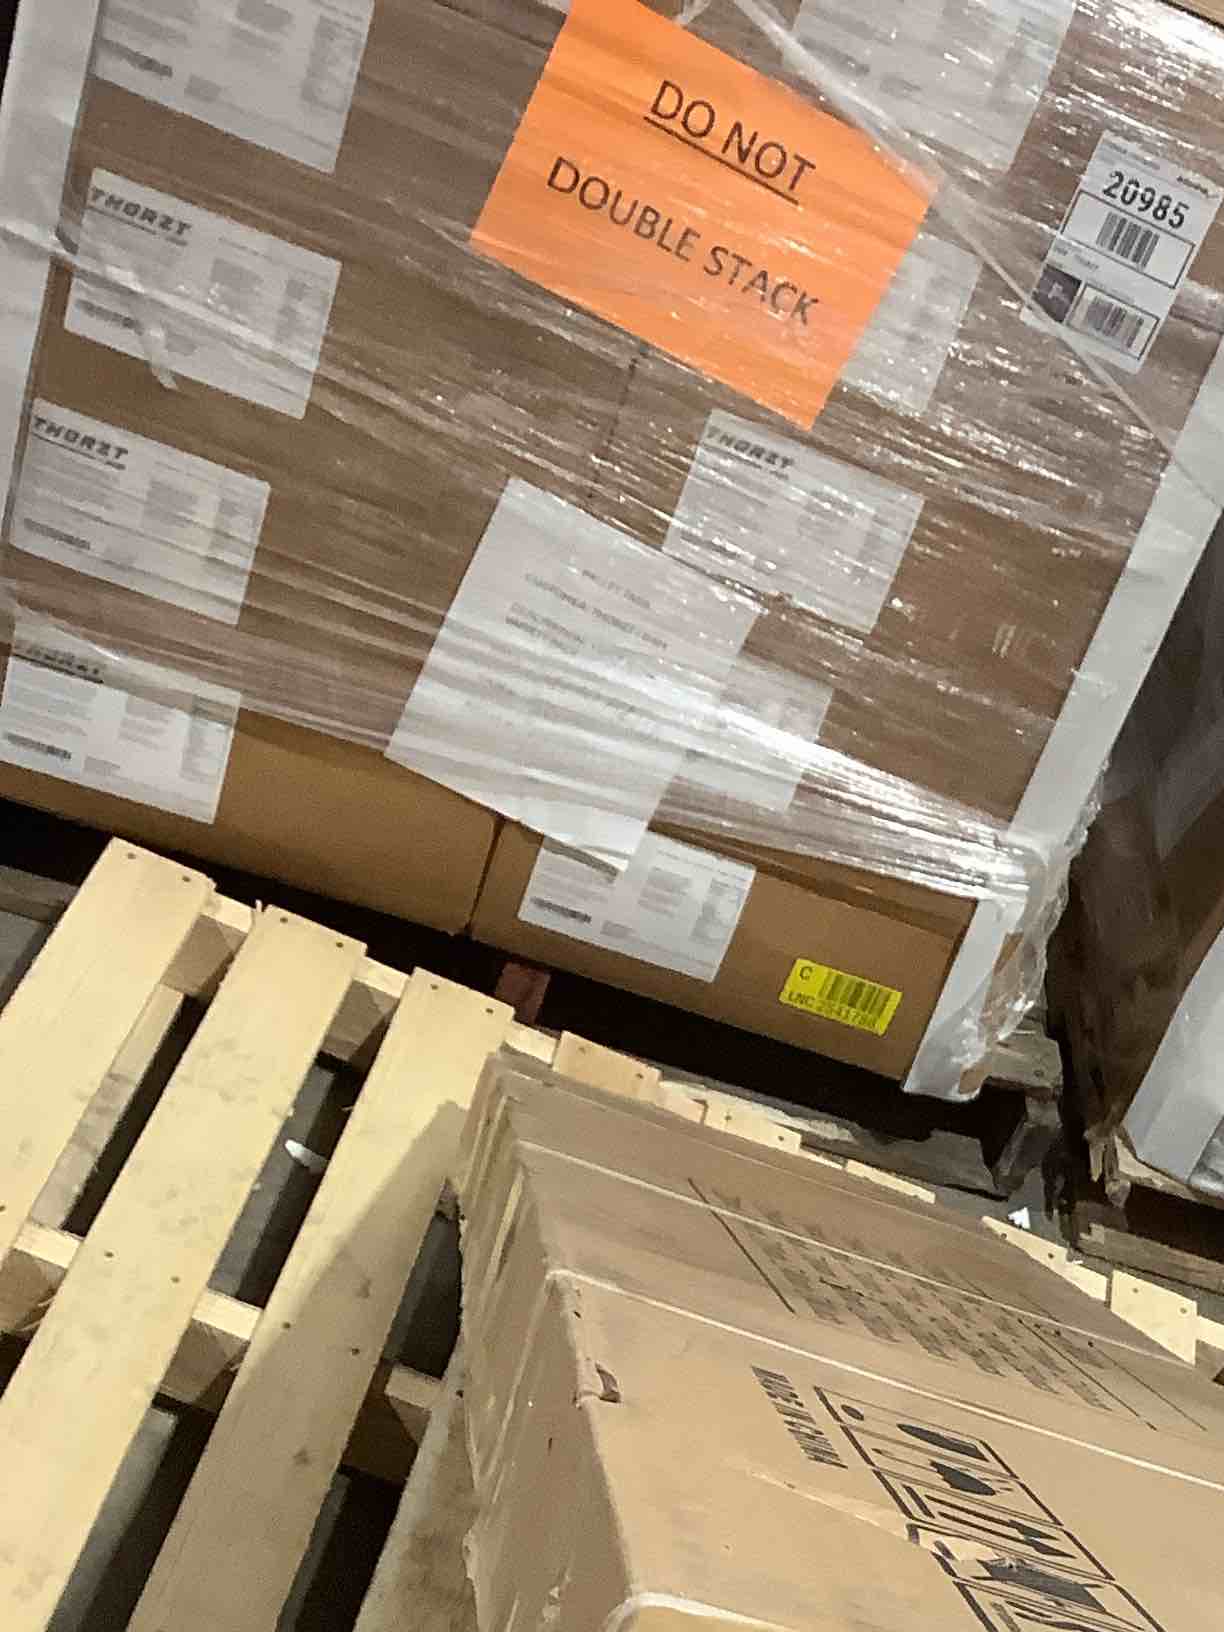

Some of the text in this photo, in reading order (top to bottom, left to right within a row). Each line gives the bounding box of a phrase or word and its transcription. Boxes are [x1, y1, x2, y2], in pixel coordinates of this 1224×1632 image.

[650, 80, 816, 191] DO NOT
[547, 155, 819, 325] DOUBLE STACK
[1102, 169, 1188, 230] 20985
[34, 415, 129, 460] THORZT
